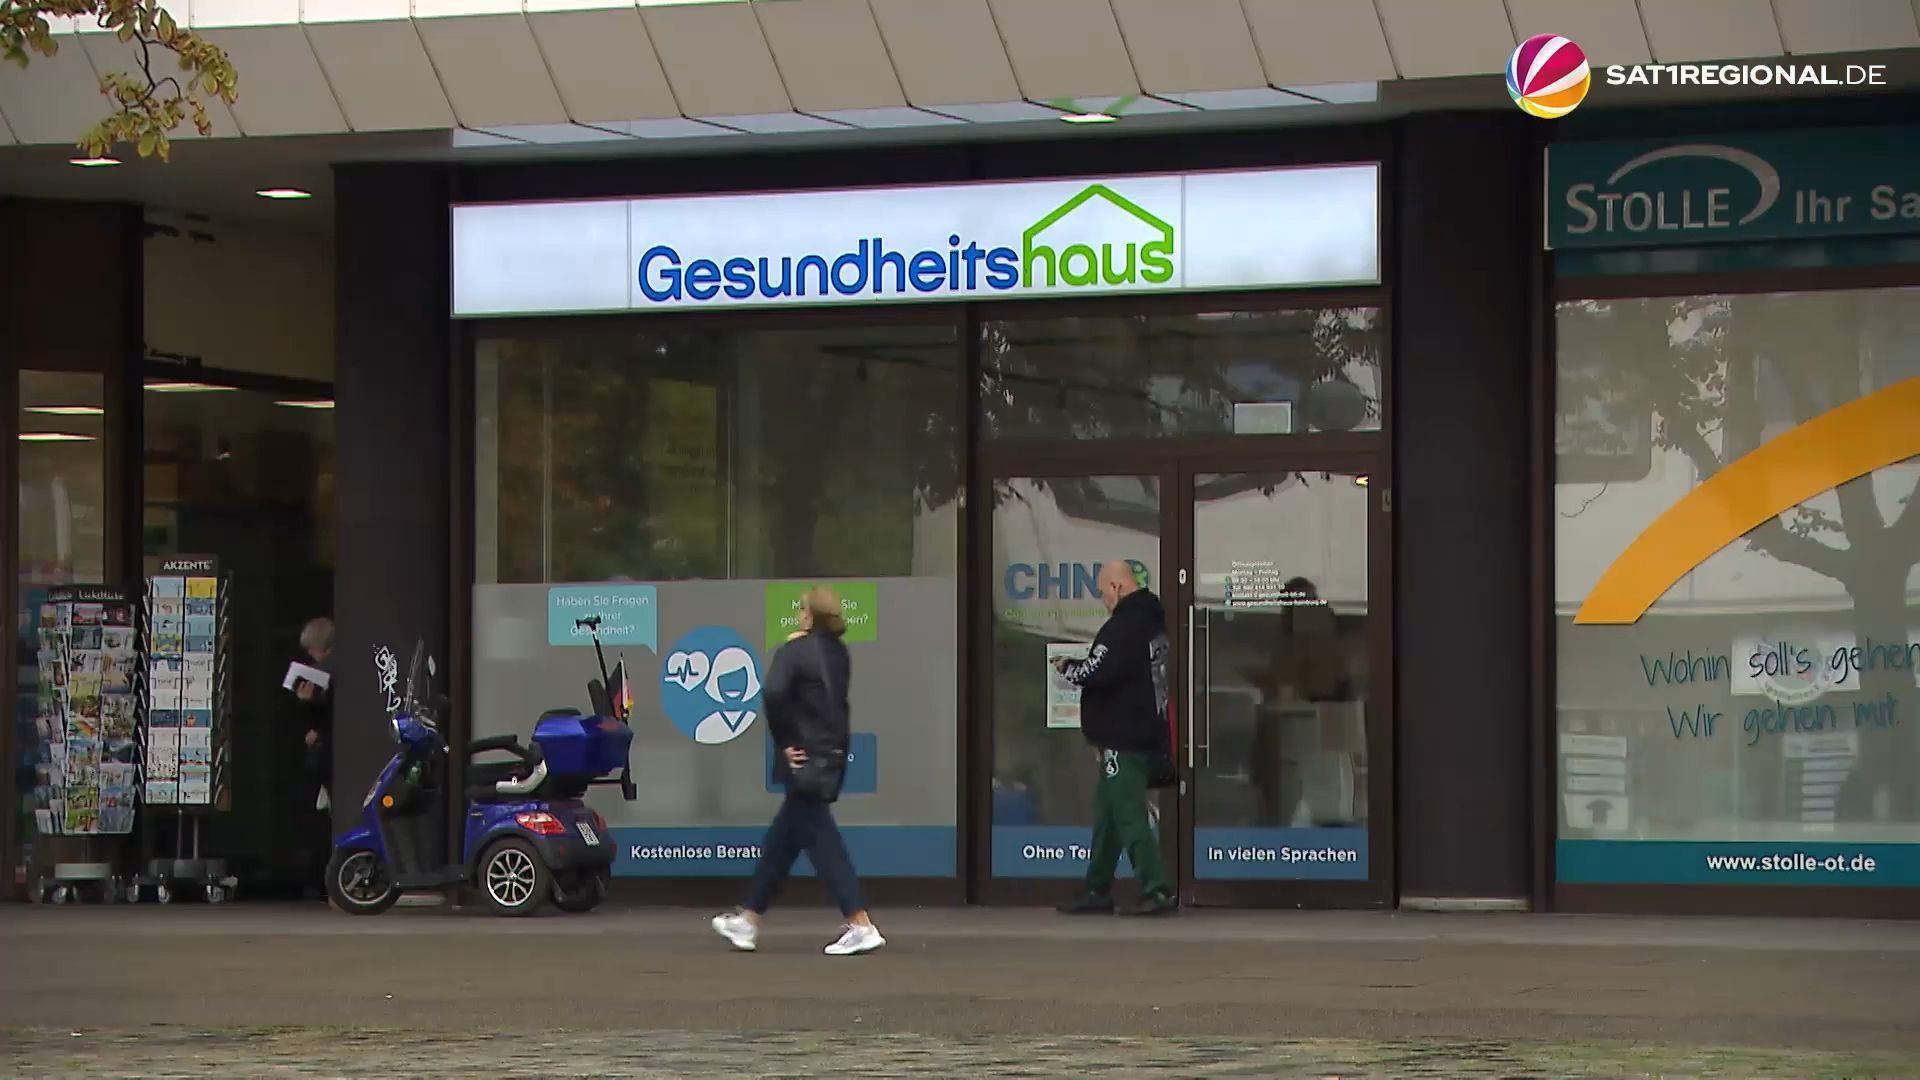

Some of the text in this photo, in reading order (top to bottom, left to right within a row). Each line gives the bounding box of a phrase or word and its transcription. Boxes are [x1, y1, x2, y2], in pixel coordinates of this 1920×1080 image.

[1565, 183, 1731, 234] STOLLE
[1795, 189, 1852, 224] Ihr
[638, 222, 1174, 302] Gesundheitshaus
[163, 561, 211, 571] AKZENTE
[556, 595, 649, 608] Haben Sie Fragen
[841, 600, 857, 610] Sie
[1640, 650, 1731, 686] Wohin
[1749, 641, 1812, 678] soll's
[1667, 704, 1723, 739] Wir
[1743, 700, 1836, 746] gehen
[631, 845, 764, 859] Kostenlose Beratu
[1022, 845, 1065, 860] Ohne
[1208, 846, 1357, 865] In vielen Sprachen
[1706, 853, 1876, 873] www.stolle-ot.de
